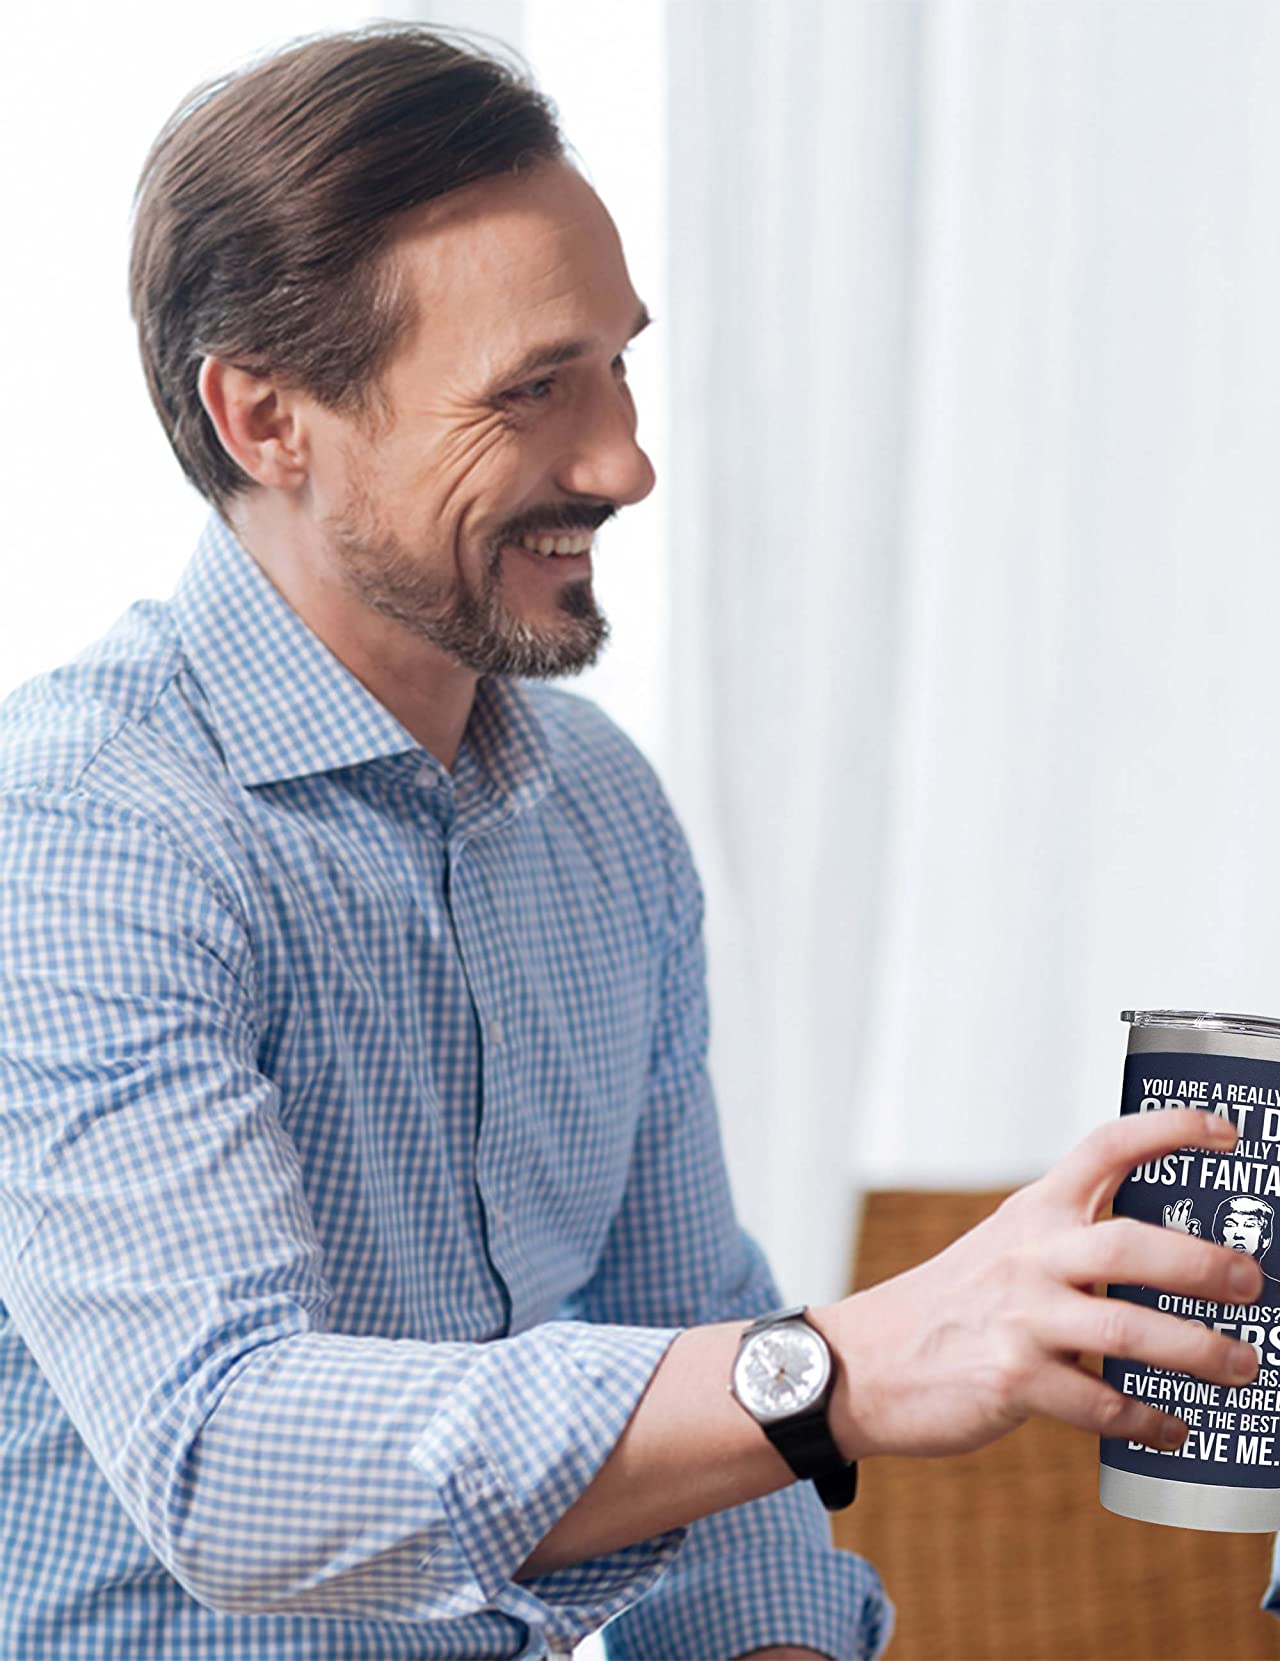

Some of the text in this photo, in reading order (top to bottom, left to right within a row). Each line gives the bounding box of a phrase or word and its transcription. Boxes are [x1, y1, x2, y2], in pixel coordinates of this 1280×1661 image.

[1142, 1078, 1174, 1097] YOU
[1177, 1080, 1209, 1099] ARE
[1211, 1083, 1223, 1100] A
[1215, 1139, 1270, 1161] ALLY
[1131, 1154, 1195, 1187] JUST
[1158, 1294, 1218, 1319] OTHER
[1123, 1372, 1221, 1407] EVERYONE
[1174, 1406, 1204, 1427] ARE
[1207, 1410, 1235, 1430] THE
[1240, 1413, 1280, 1433] BEST
[1235, 1435, 1280, 1467] ME.
